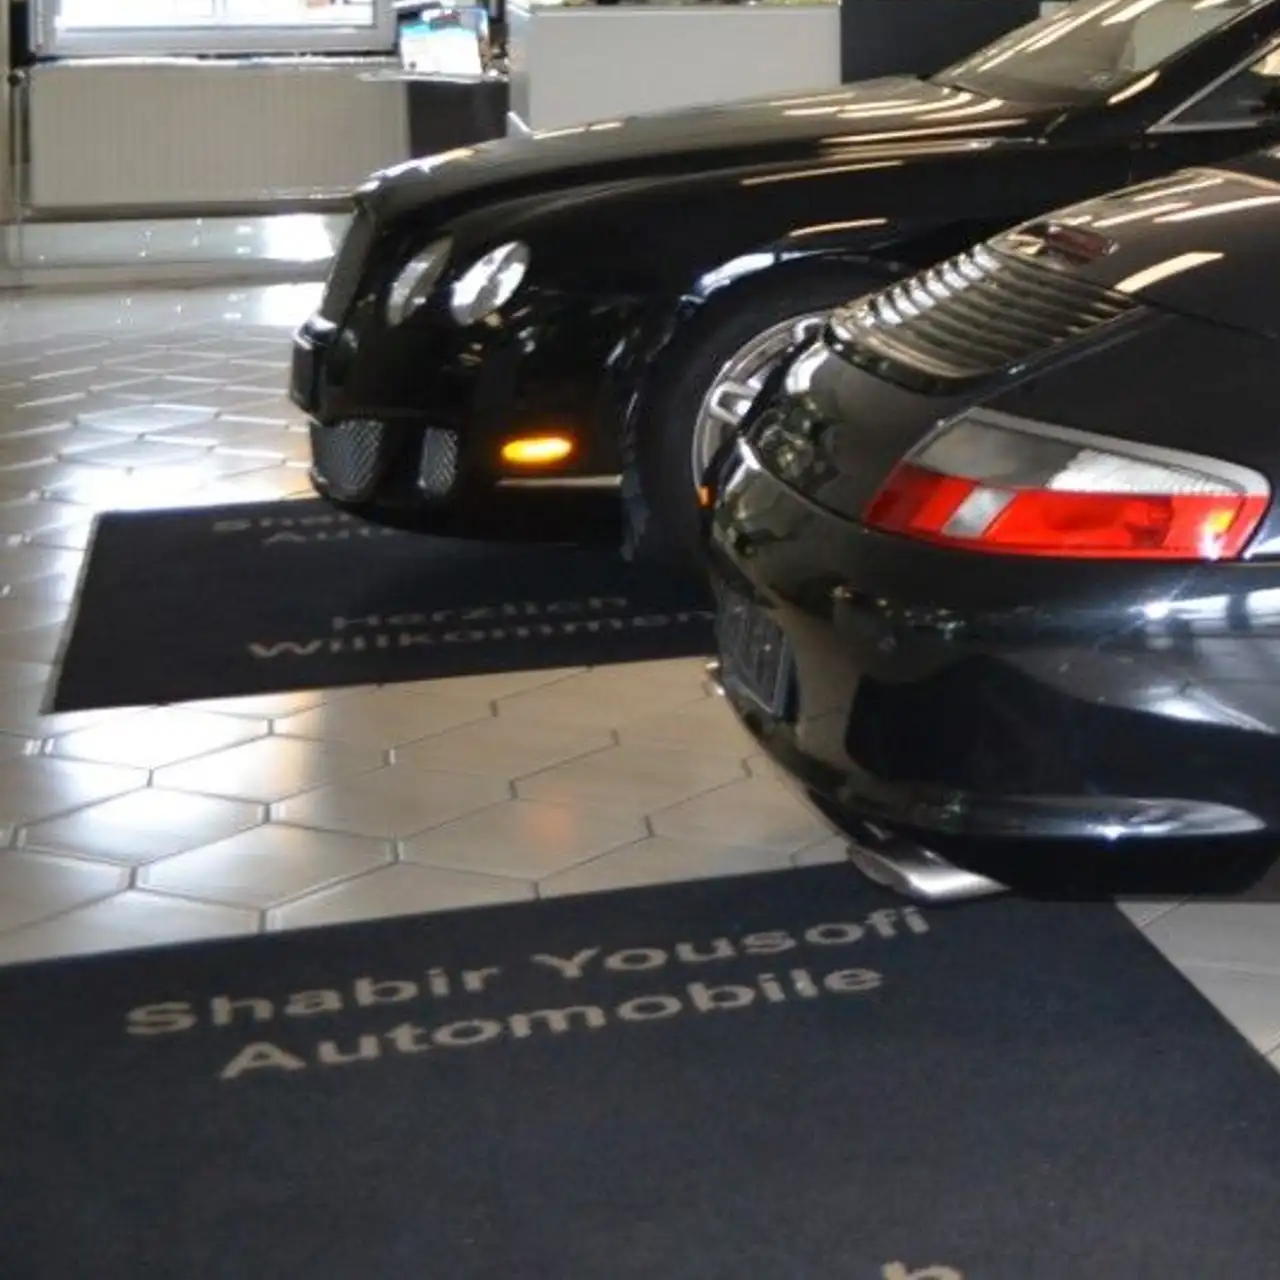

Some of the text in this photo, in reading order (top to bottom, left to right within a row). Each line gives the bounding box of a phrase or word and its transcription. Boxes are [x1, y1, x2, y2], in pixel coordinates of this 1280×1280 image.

[248, 610, 715, 659] Willkommen
[126, 905, 931, 1036] Shabir Yousofi
[219, 968, 885, 1080] Automobile
